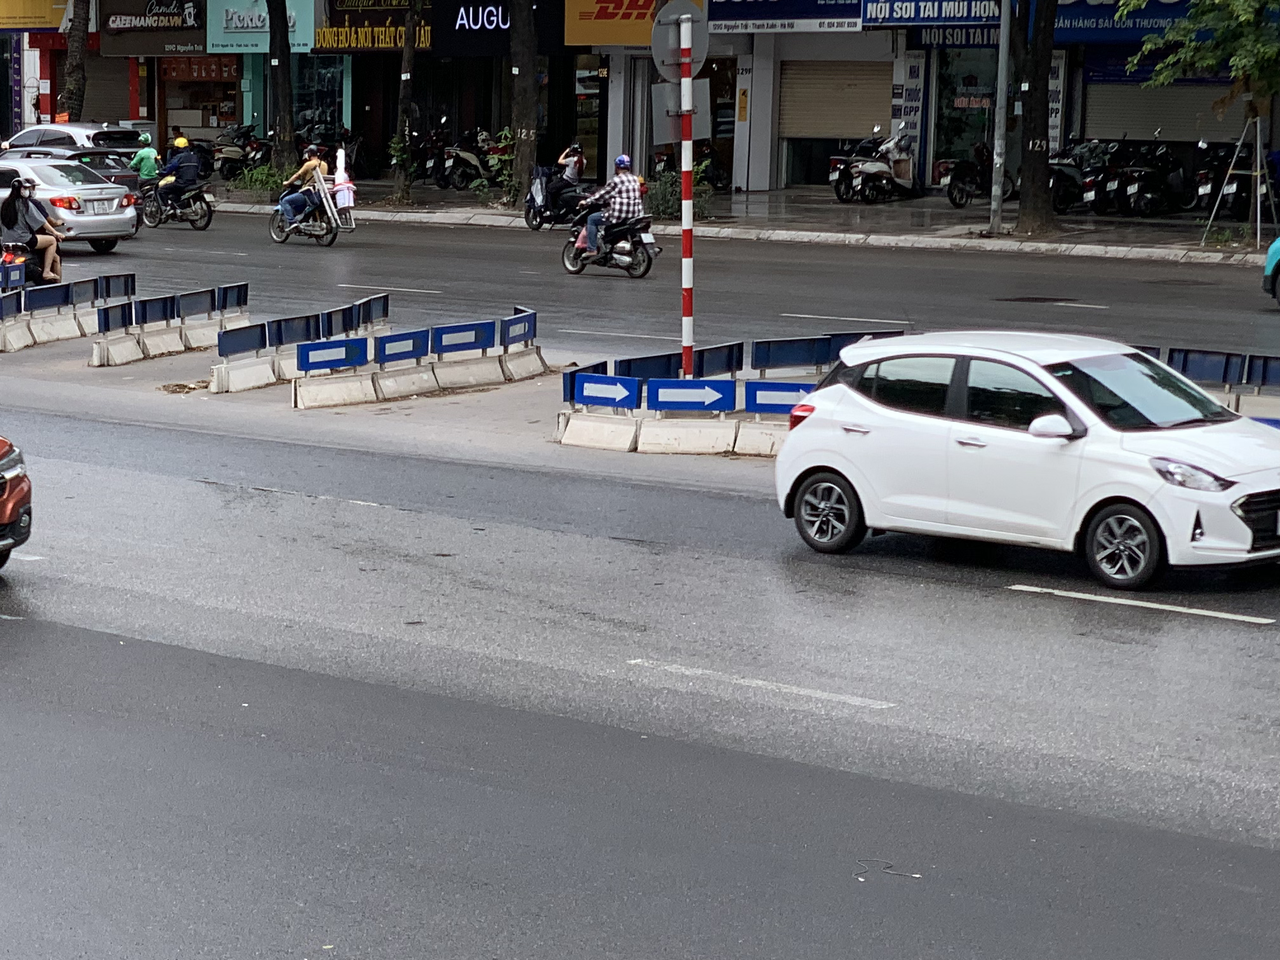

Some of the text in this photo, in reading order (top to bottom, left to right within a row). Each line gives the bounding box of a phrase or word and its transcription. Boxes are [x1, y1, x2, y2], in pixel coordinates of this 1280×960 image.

[455, 6, 512, 30] AUGU
[866, 0, 890, 23] NỘI
[893, 1, 915, 18] SOI
[918, 1, 938, 18] TAI
[971, 1, 1000, 22] HỌN
[1072, 16, 1097, 29] HÀNG
[1098, 16, 1113, 29] SÀI
[921, 25, 943, 48] NỘI
[945, 28, 966, 45] SOI
[969, 28, 988, 45] TAI
[903, 106, 920, 117] GPP
[516, 127, 537, 141] 125
